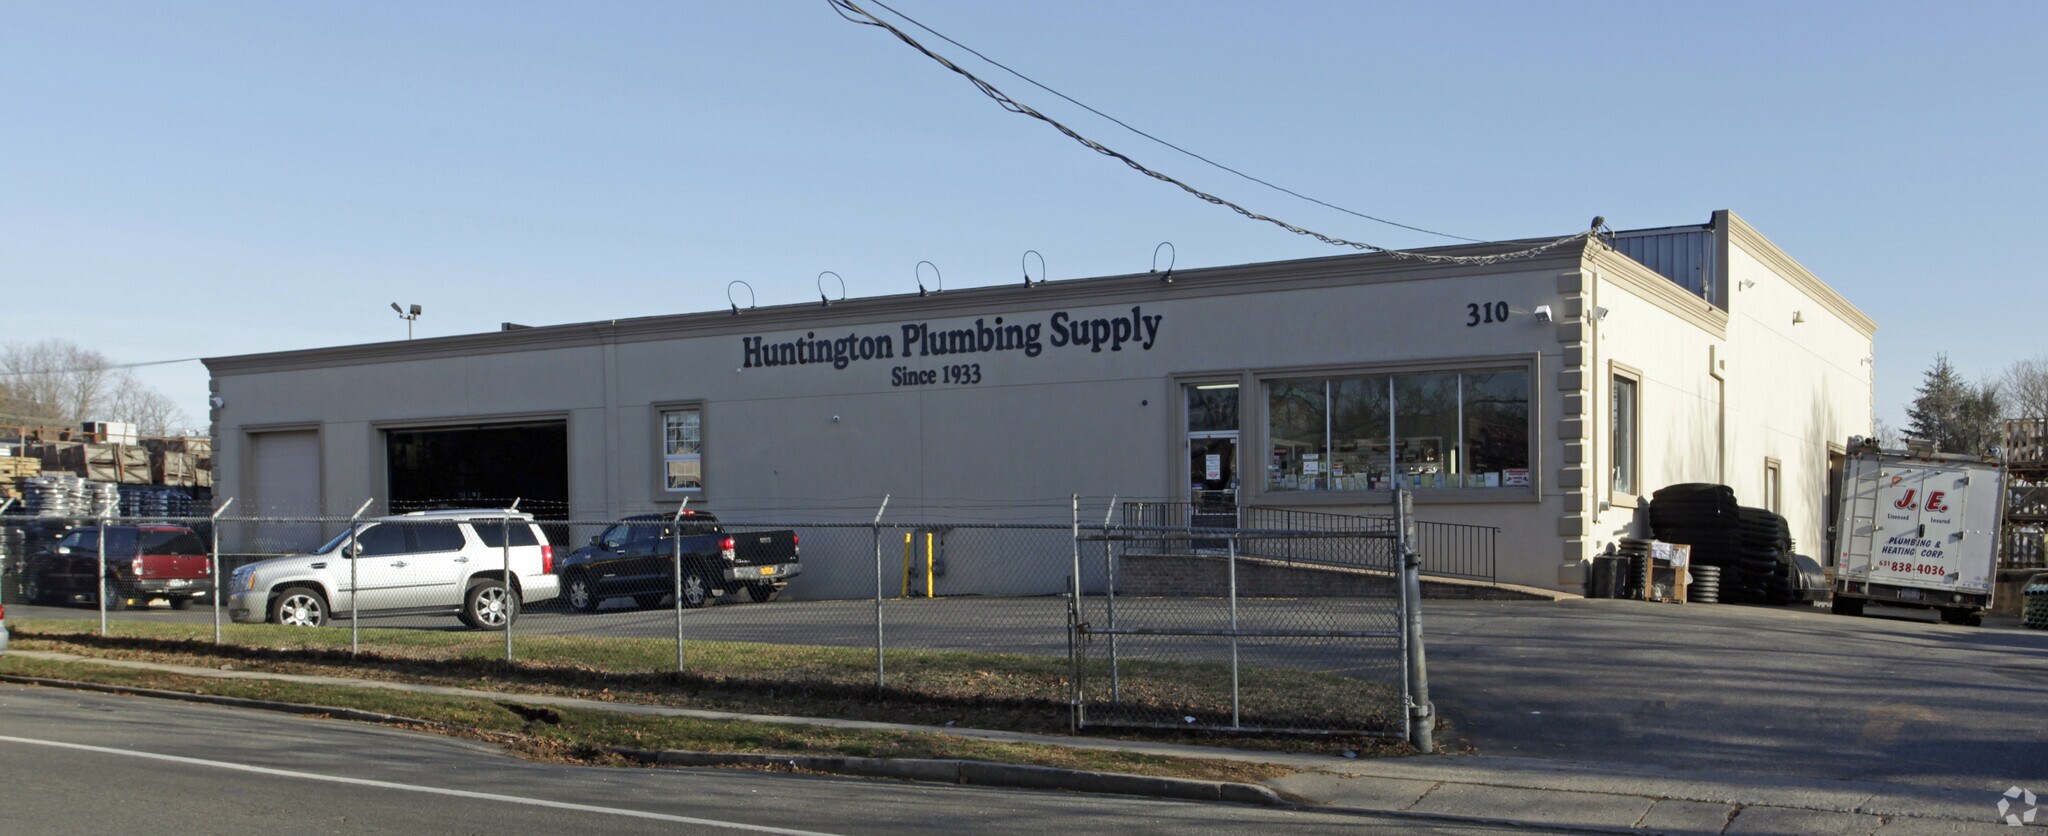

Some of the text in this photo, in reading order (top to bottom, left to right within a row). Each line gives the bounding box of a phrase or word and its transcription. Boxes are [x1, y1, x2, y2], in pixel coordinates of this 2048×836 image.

[1466, 301, 1509, 327] 310
[743, 305, 1163, 370] Huntington Plumbing Supply
[891, 363, 982, 387] Since 1933
[1894, 489, 1949, 513] J. E.
[1887, 513, 1910, 521] Licensed
[1930, 517, 1951, 525] Insured
[1888, 536, 1942, 549] PLUMBING &
[1881, 546, 1945, 559] HEATING CORP.
[1891, 561, 1946, 577] 838-4036
